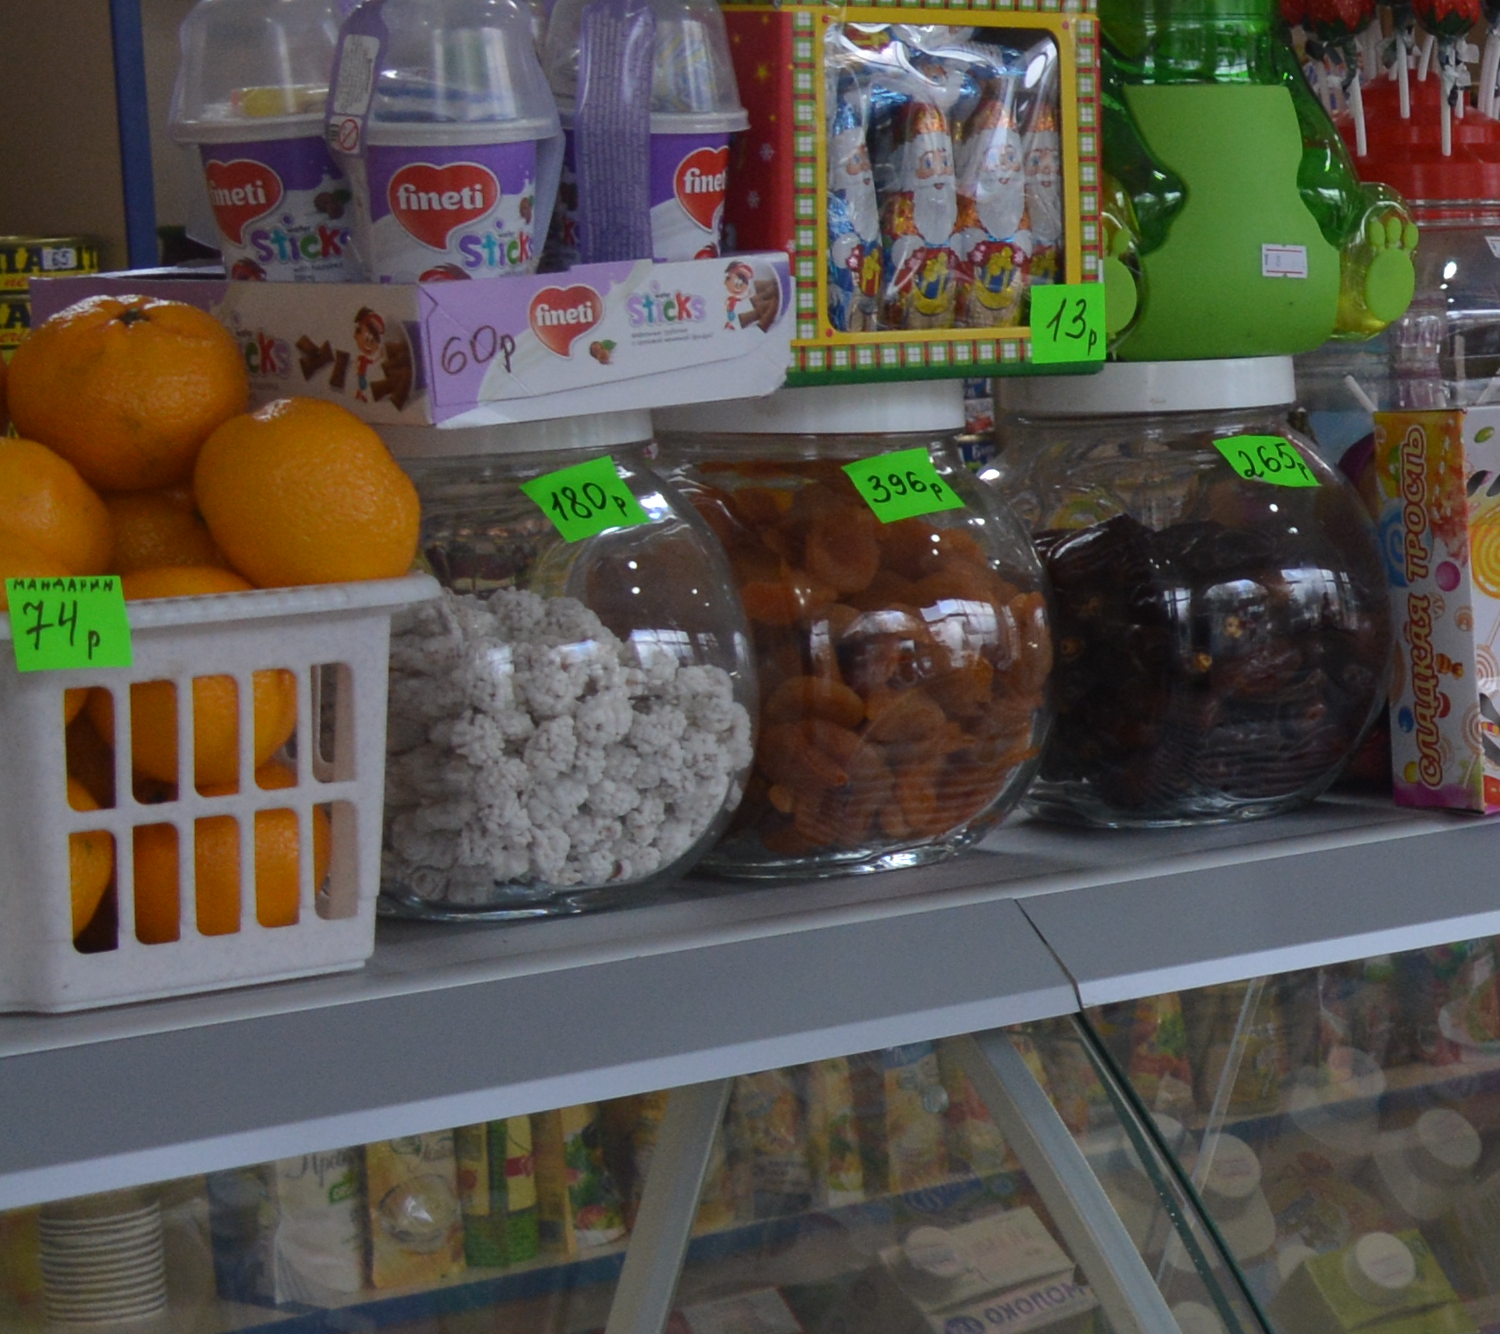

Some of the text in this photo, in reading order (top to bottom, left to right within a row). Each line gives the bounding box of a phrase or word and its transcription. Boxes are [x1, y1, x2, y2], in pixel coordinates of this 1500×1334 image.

[398, 184, 484, 212] fineti
[537, 304, 595, 328] fineti
[627, 284, 708, 327] Sticks
[1047, 297, 1097, 354] 13р
[549, 482, 627, 525] 180р
[866, 470, 945, 505] 396р
[12, 577, 114, 593] МАНДАРИН
[22, 599, 101, 659] 74р
